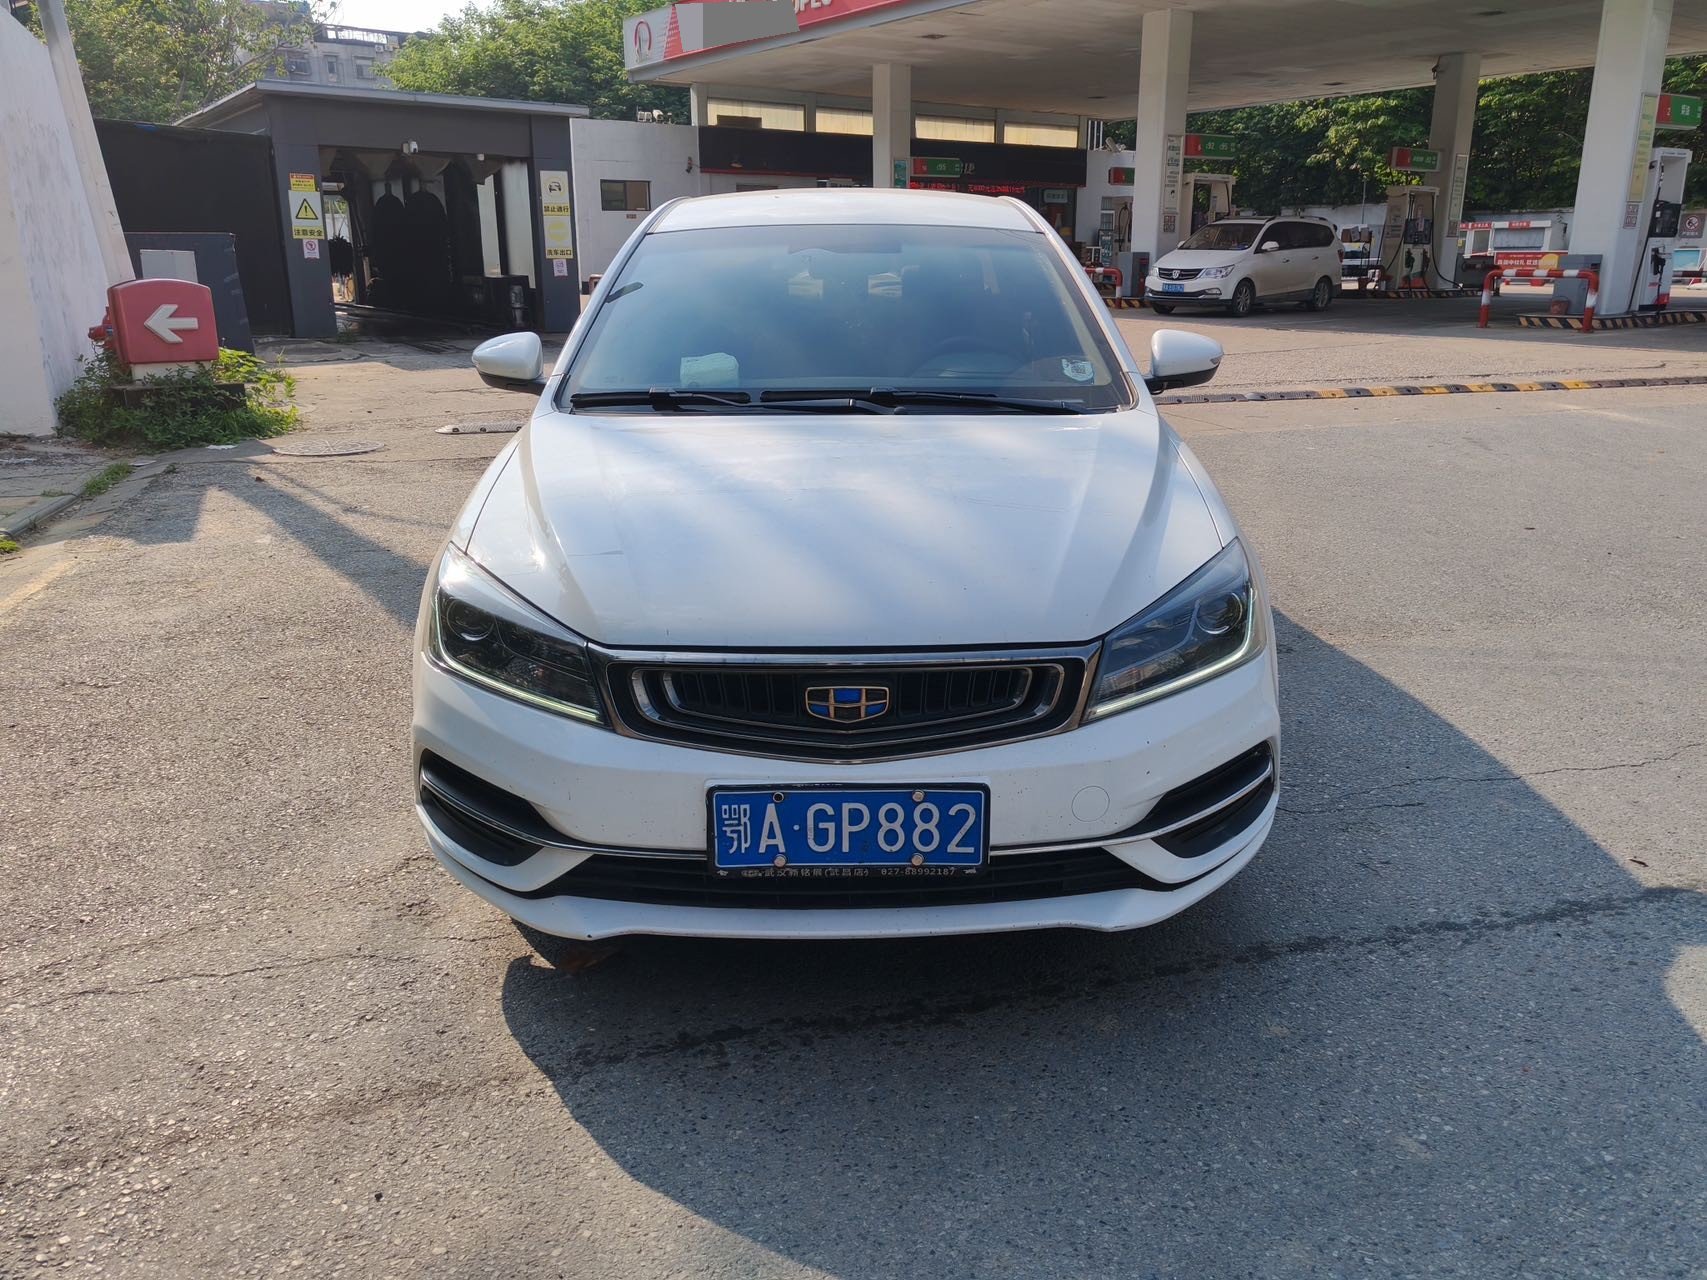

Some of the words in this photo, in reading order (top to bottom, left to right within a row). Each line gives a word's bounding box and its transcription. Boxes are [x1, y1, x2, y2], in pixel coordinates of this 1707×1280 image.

[544, 205, 570, 214] 禁止通行
[294, 229, 323, 238] 注意安全
[546, 248, 573, 257] 洗车出口
